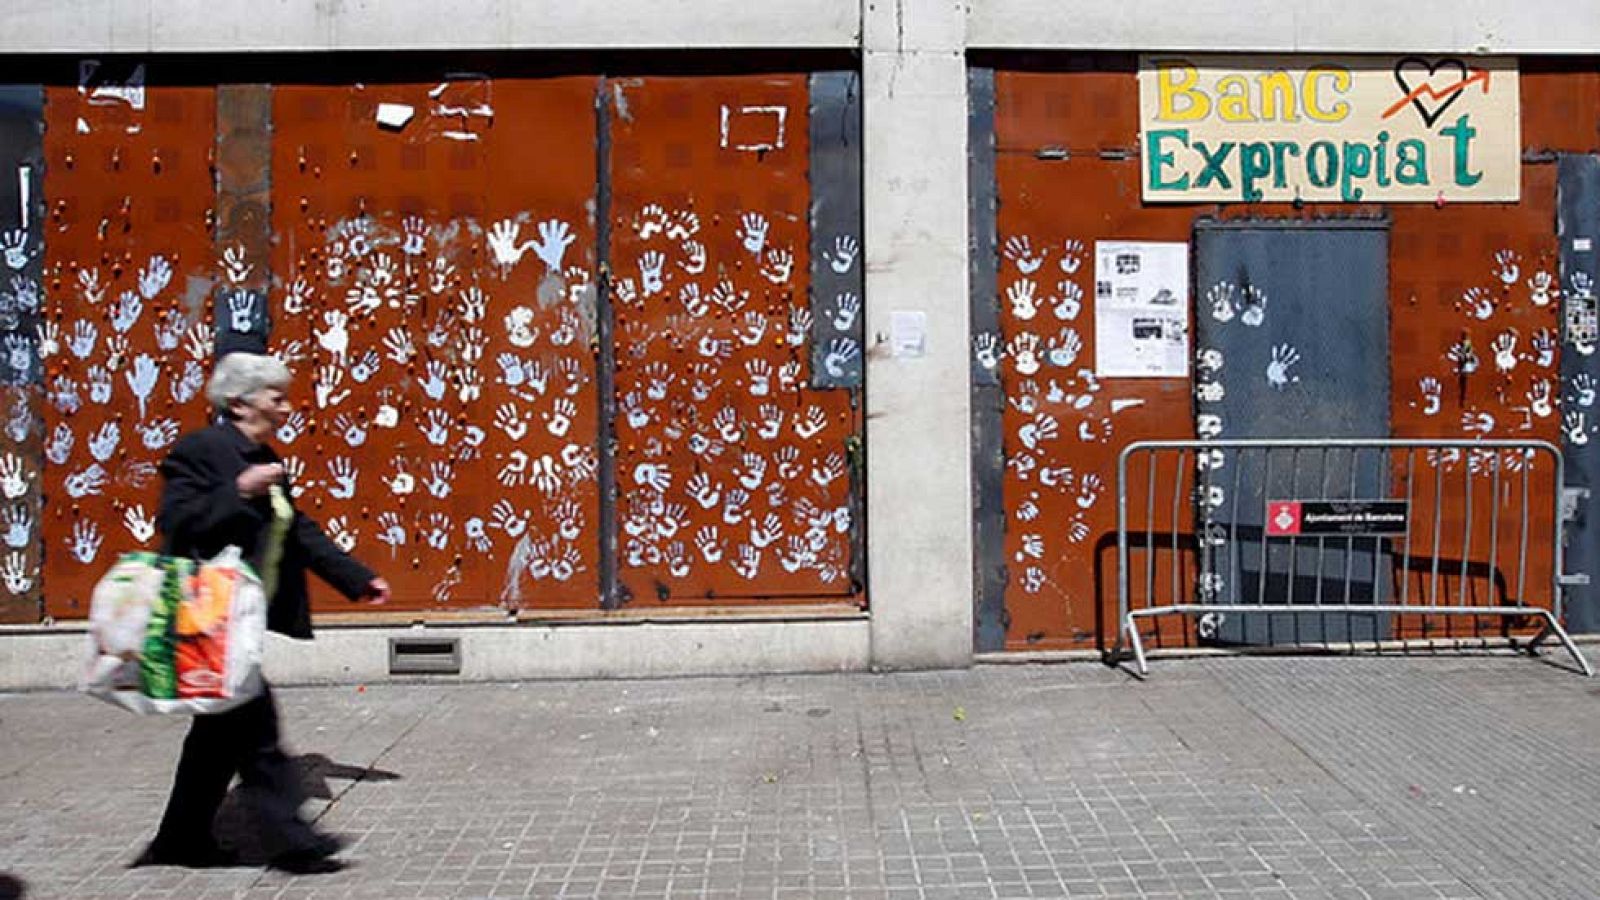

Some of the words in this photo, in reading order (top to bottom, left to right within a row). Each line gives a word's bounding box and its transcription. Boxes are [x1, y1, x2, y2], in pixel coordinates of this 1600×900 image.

[1146, 114, 1484, 202] Expropiat
[1354, 513, 1363, 522] de
[1365, 513, 1405, 522] Barcelona
